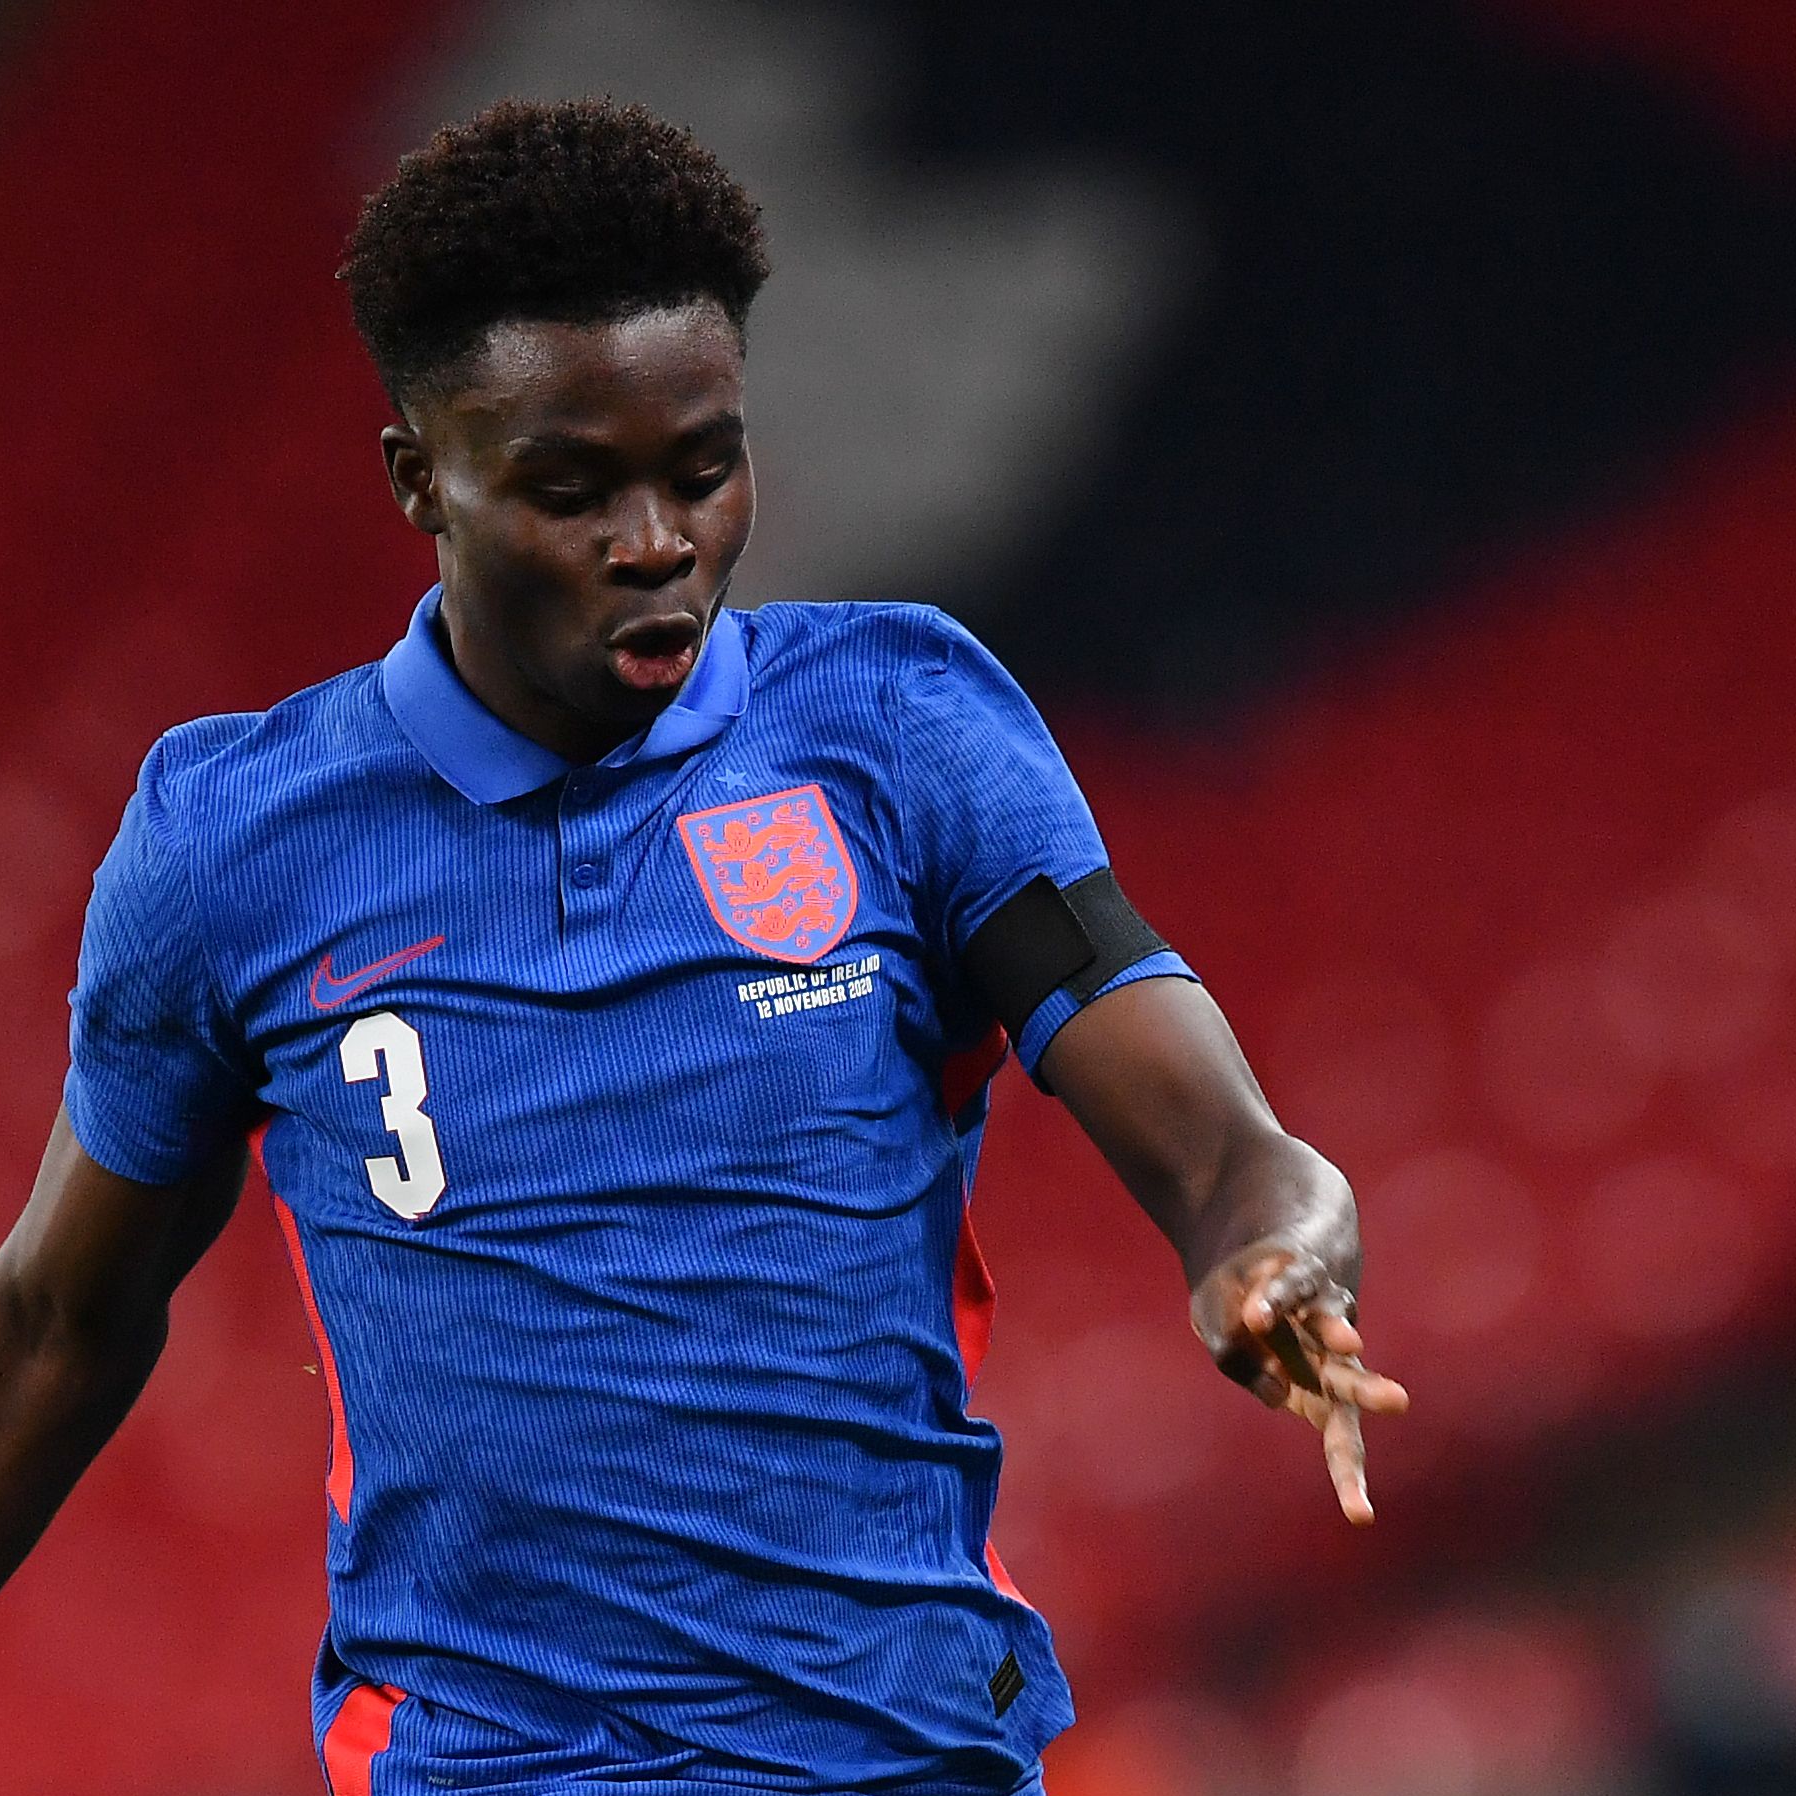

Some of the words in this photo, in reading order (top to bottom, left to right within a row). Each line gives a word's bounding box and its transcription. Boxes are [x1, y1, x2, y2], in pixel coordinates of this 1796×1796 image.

[737, 972, 808, 1003] REPUBLIC
[810, 969, 828, 987] OF
[831, 953, 881, 983] IRELAND
[755, 999, 773, 1020] 12
[773, 984, 847, 1016] NOVEMBER
[847, 974, 873, 1000] 2020
[339, 1010, 448, 1220] 3
